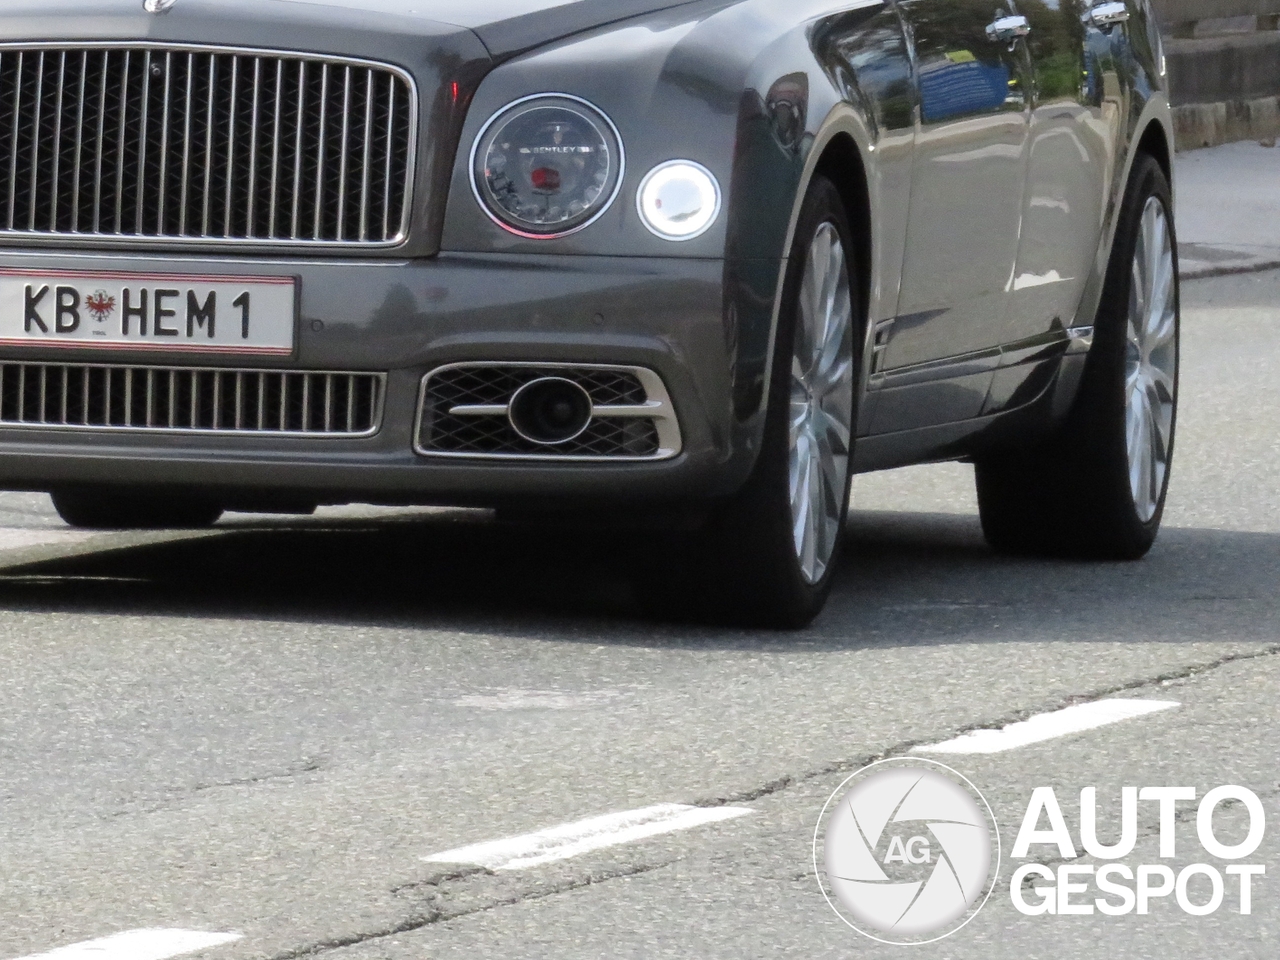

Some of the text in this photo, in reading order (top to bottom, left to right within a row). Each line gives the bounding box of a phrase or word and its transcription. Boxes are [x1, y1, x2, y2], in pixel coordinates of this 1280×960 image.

[24, 284, 250, 338] KB HEM 1
